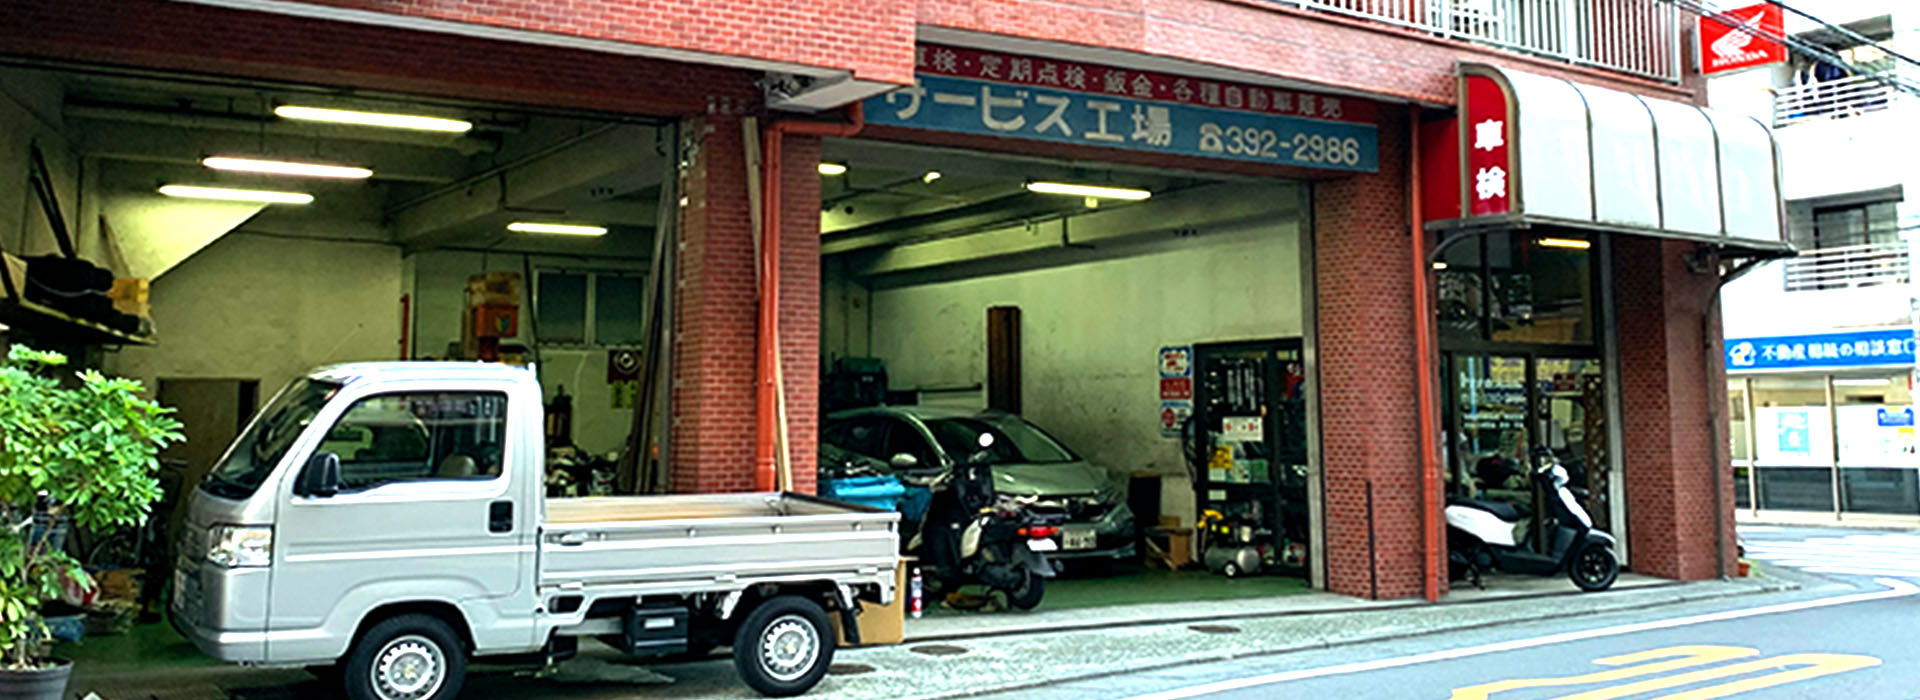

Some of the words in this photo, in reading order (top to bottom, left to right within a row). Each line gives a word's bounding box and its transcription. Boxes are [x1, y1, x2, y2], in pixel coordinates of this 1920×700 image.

[886, 77, 1172, 148] サービス工場
[1226, 125, 1359, 166] 392-2986
[1474, 118, 1506, 200] 車検
